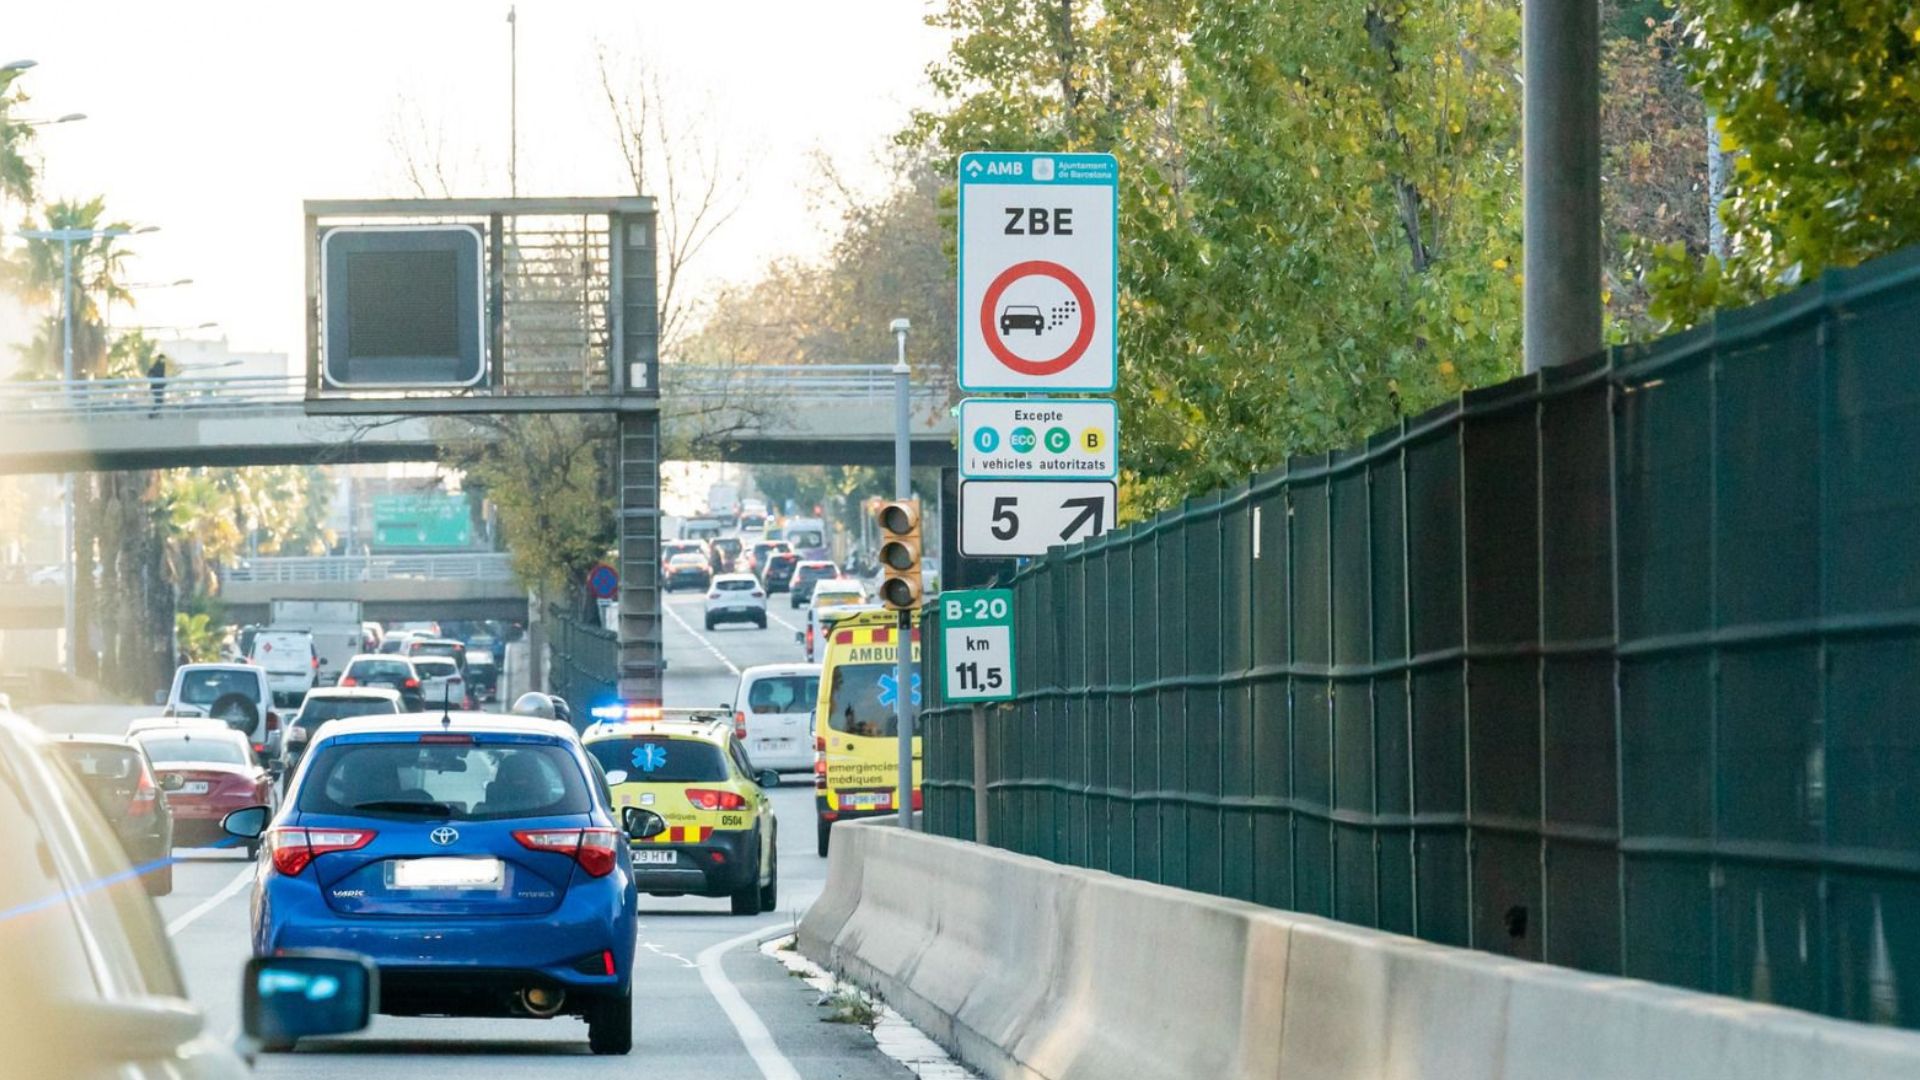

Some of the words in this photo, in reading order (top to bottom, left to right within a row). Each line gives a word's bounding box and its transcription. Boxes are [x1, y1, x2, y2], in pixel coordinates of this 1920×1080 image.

[987, 161, 1023, 175] AMB
[1058, 161, 1107, 170] Ajuntament
[1058, 170, 1069, 179] de
[1071, 170, 1112, 179] Barcelona
[1004, 207, 1073, 235] ZBE
[1015, 410, 1063, 423] Excepte
[981, 433, 992, 447] 0
[1010, 434, 1036, 446] ECO
[1051, 433, 1064, 448] C
[1087, 434, 1098, 447] B
[982, 458, 1032, 469] vehicles
[1040, 459, 1106, 469] autoritzats
[990, 497, 1019, 541] 5
[945, 598, 1008, 620] B-20
[966, 636, 990, 651] km
[956, 662, 1003, 692] 11,5
[721, 815, 742, 826] 0504
[631, 851, 647, 861] 09
